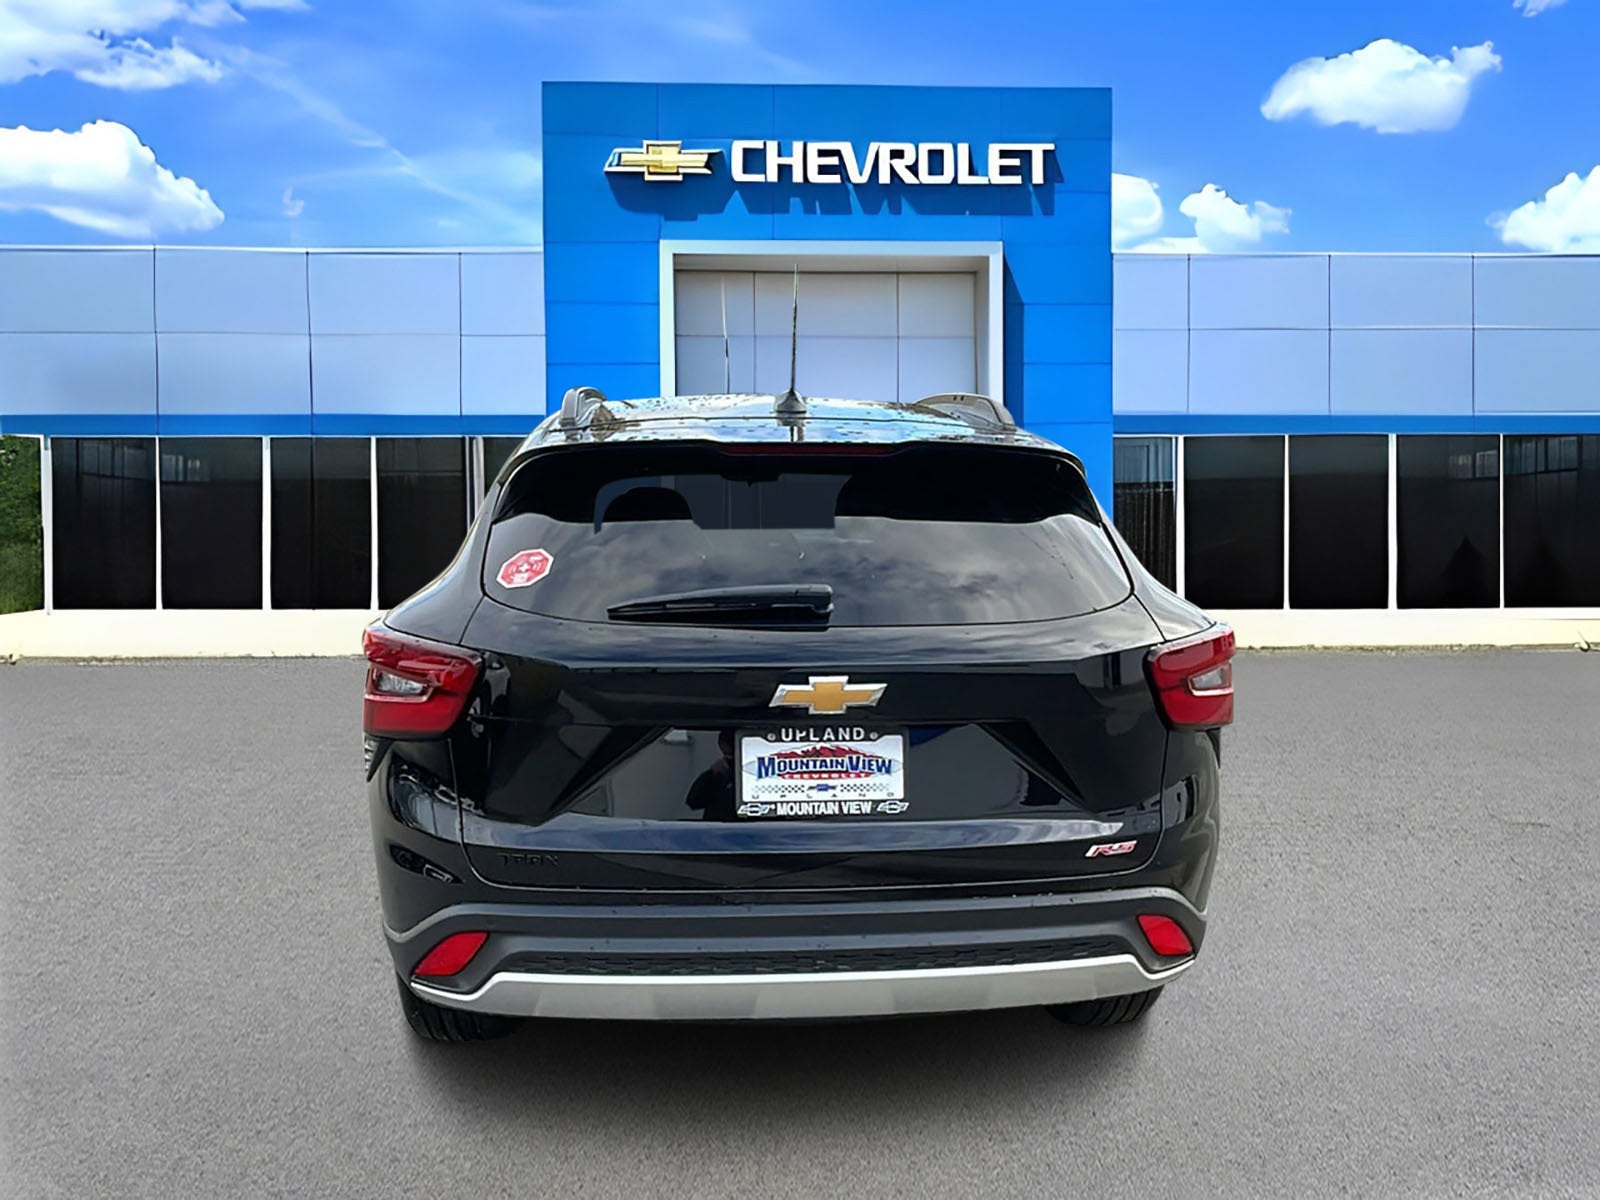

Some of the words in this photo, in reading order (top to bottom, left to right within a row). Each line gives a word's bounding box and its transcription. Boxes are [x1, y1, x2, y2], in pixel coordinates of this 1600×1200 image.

[730, 139, 1056, 185] CHEVROLET
[781, 727, 865, 741] UPLAND
[757, 756, 846, 779] MOUNTAIN
[846, 755, 892, 774] VIEW
[776, 802, 840, 815] MOUNTAIN
[841, 801, 872, 814] VIEW
[1085, 840, 1137, 857] RS
